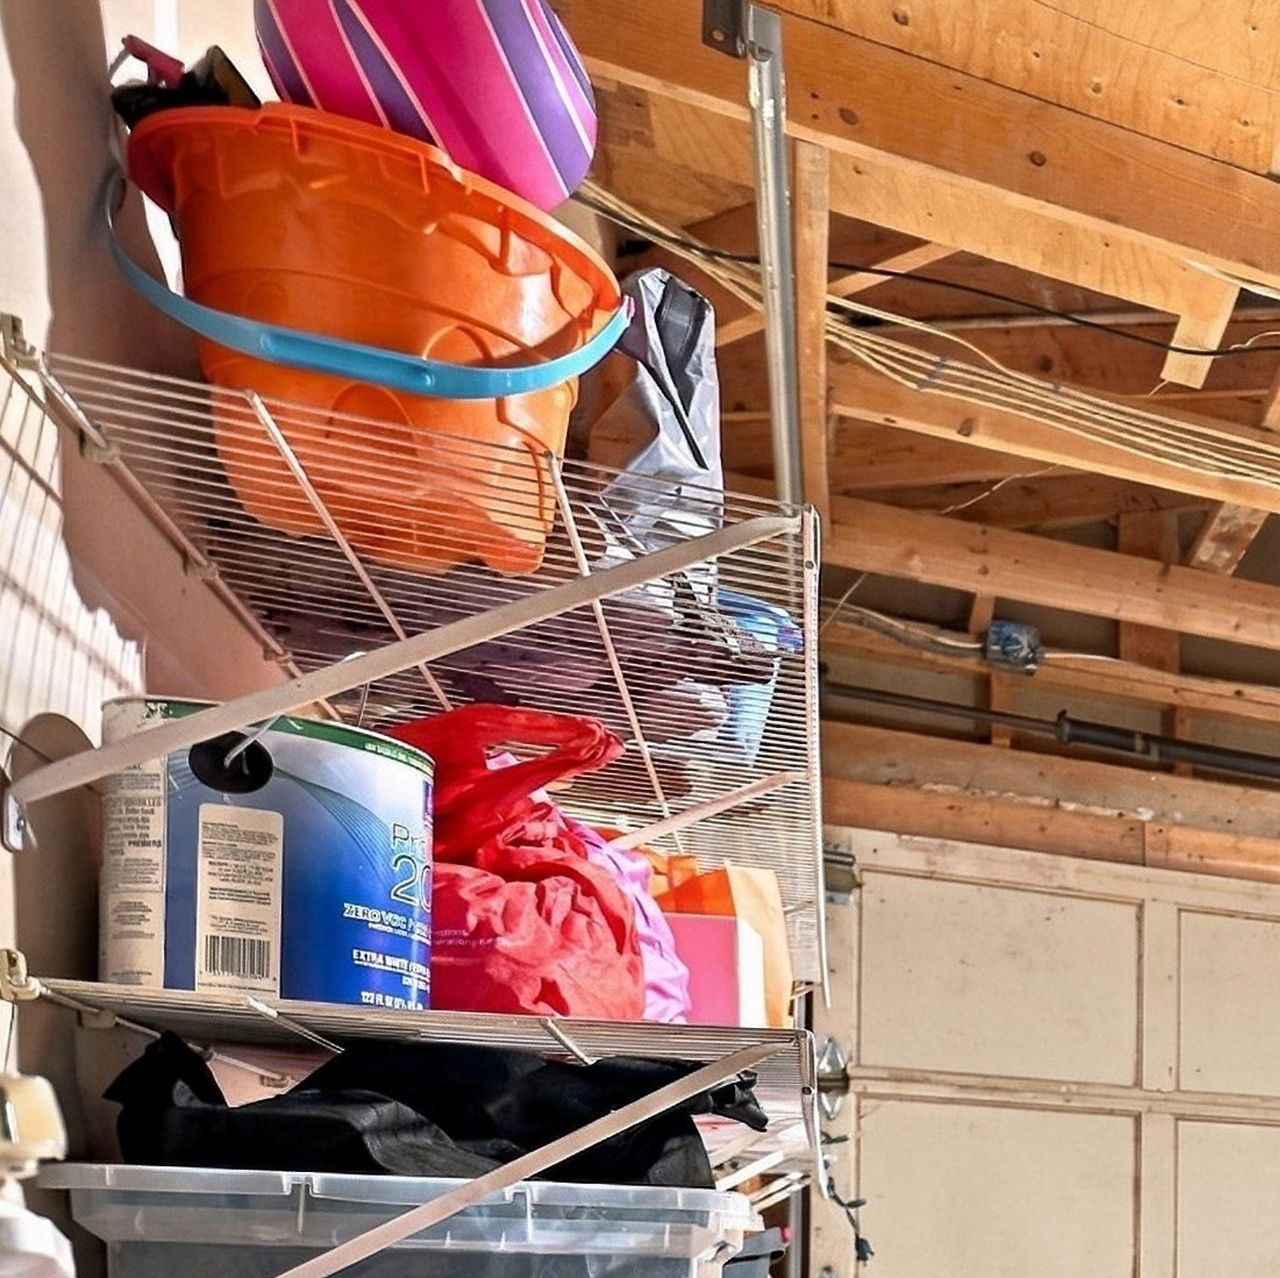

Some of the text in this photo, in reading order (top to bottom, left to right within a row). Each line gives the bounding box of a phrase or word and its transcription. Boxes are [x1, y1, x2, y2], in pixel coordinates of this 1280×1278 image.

[343, 903, 381, 925] ZERO
[381, 911, 408, 932] VOC
[353, 949, 384, 967] EXTRA
